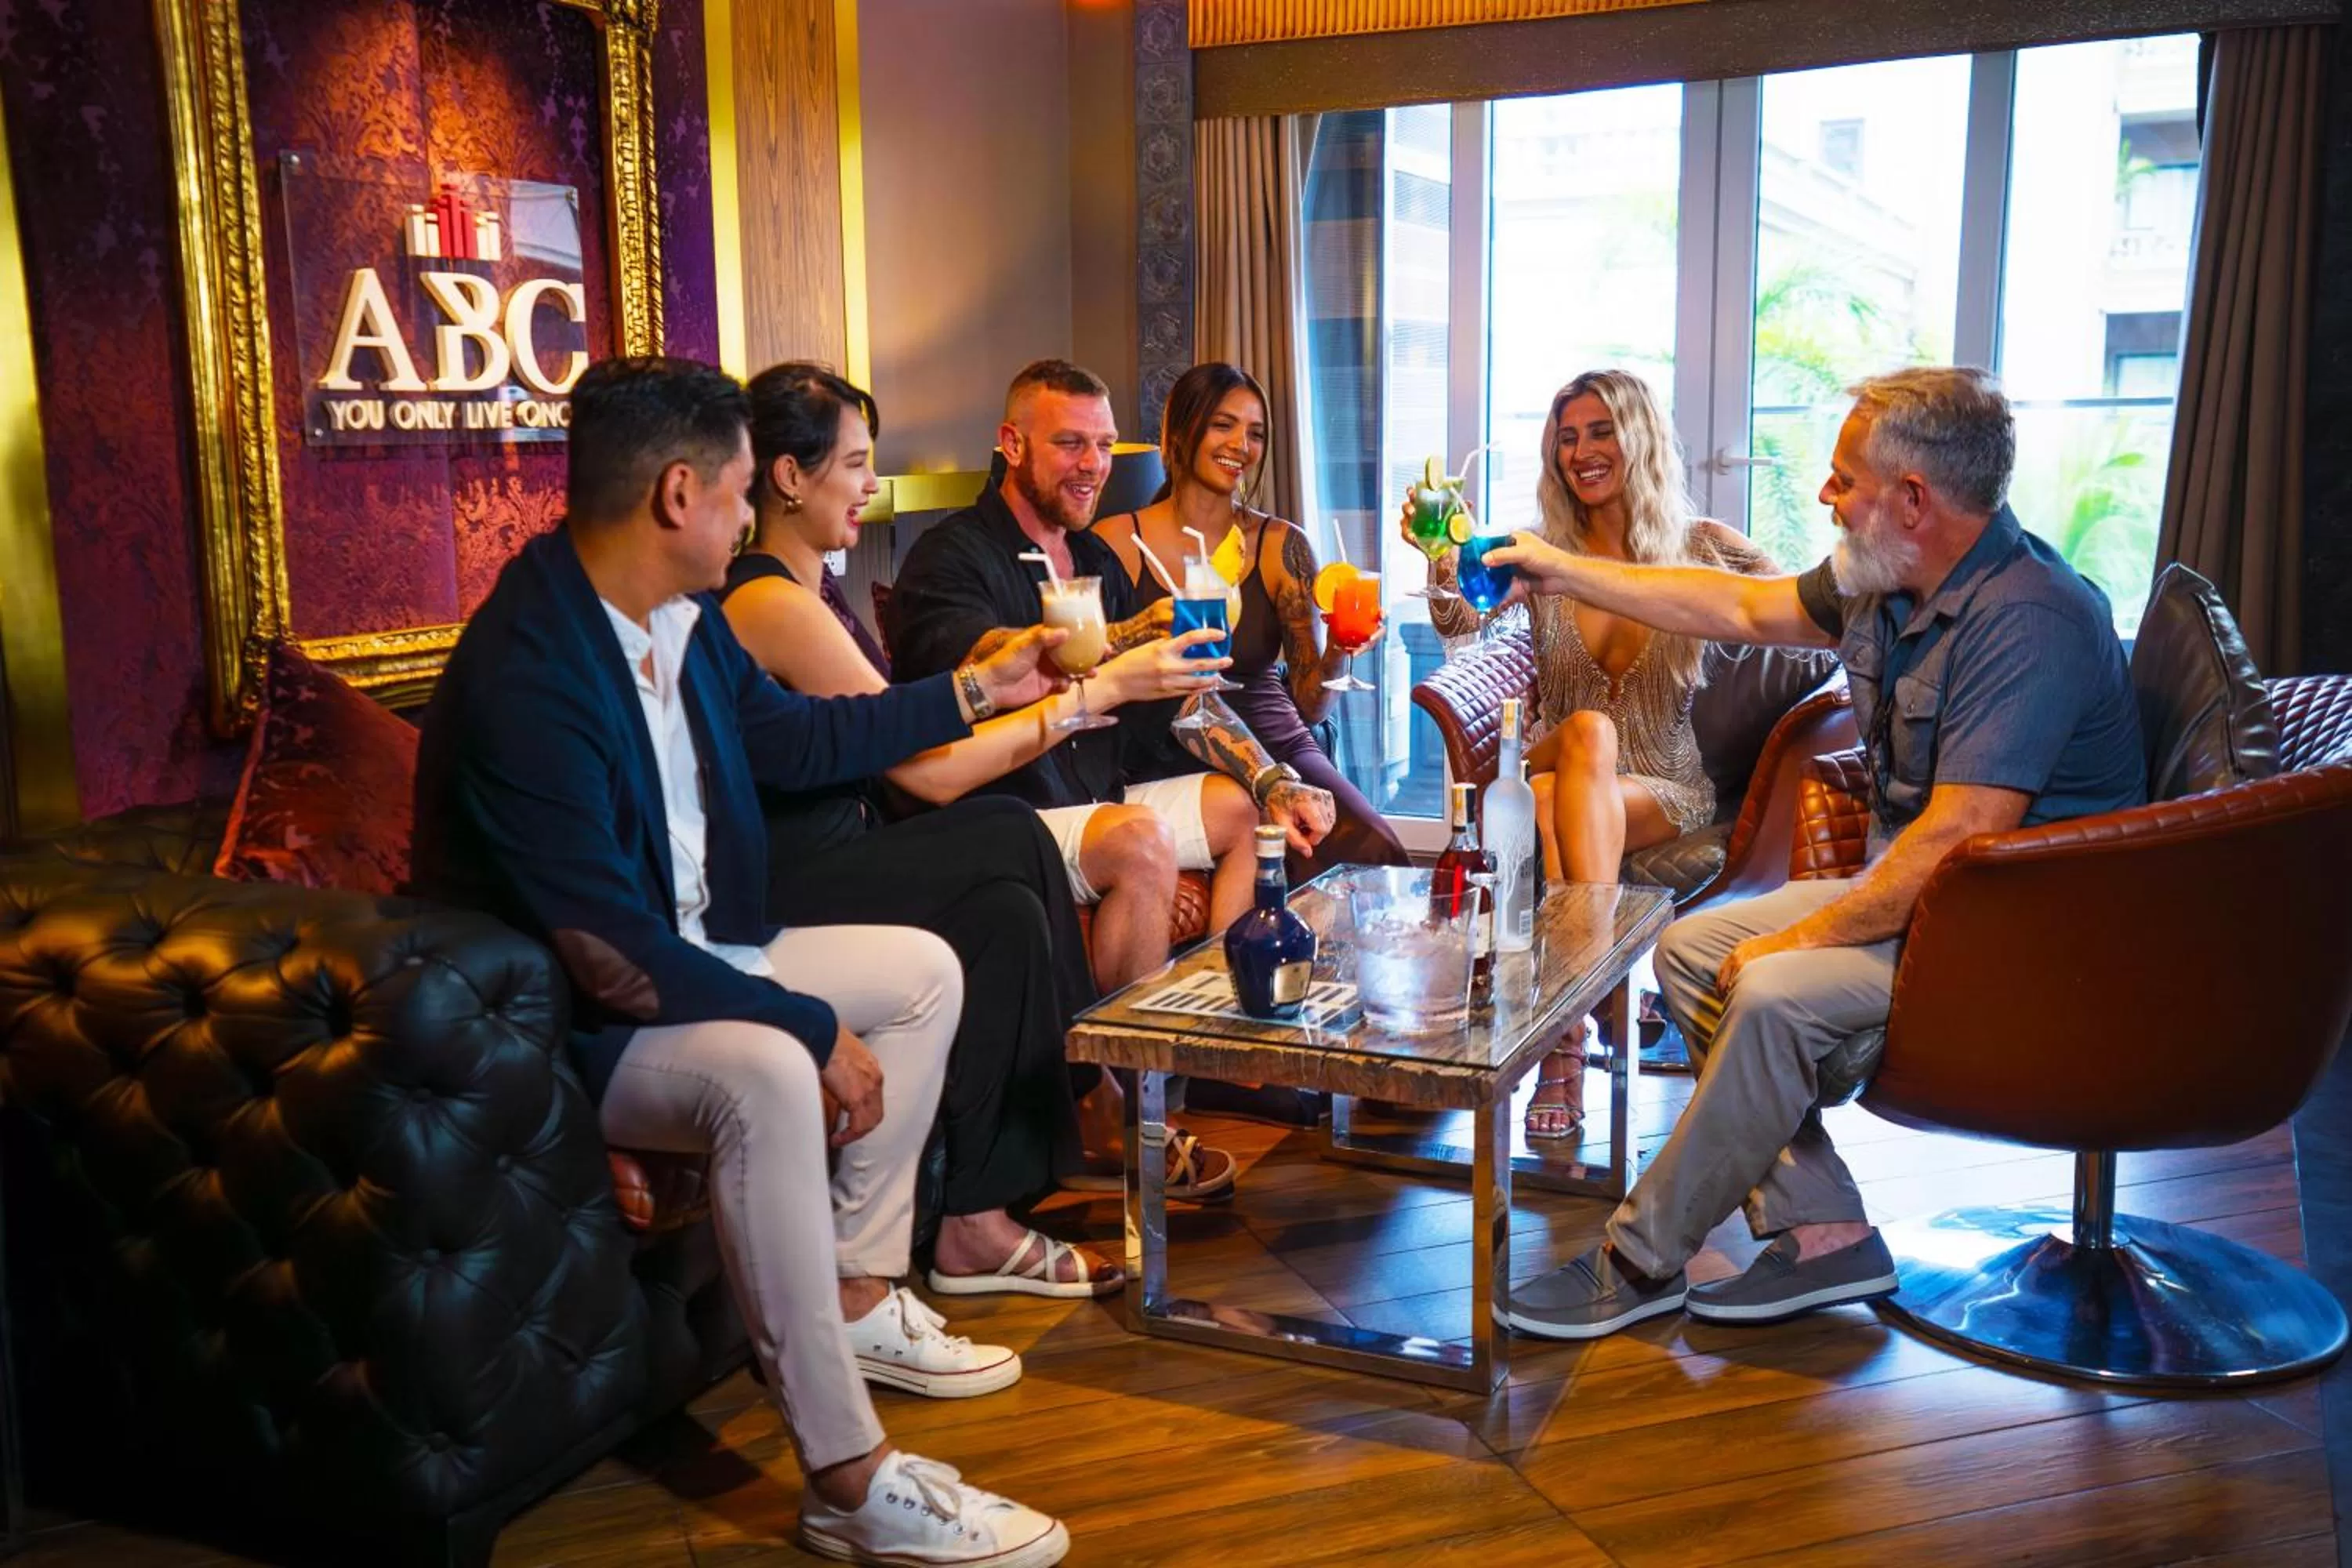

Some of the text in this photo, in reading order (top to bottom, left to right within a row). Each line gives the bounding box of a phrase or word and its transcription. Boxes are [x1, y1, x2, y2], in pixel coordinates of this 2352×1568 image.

[319, 268, 589, 394] ABC
[327, 401, 572, 430] YOU ONLY LIVE ONC
